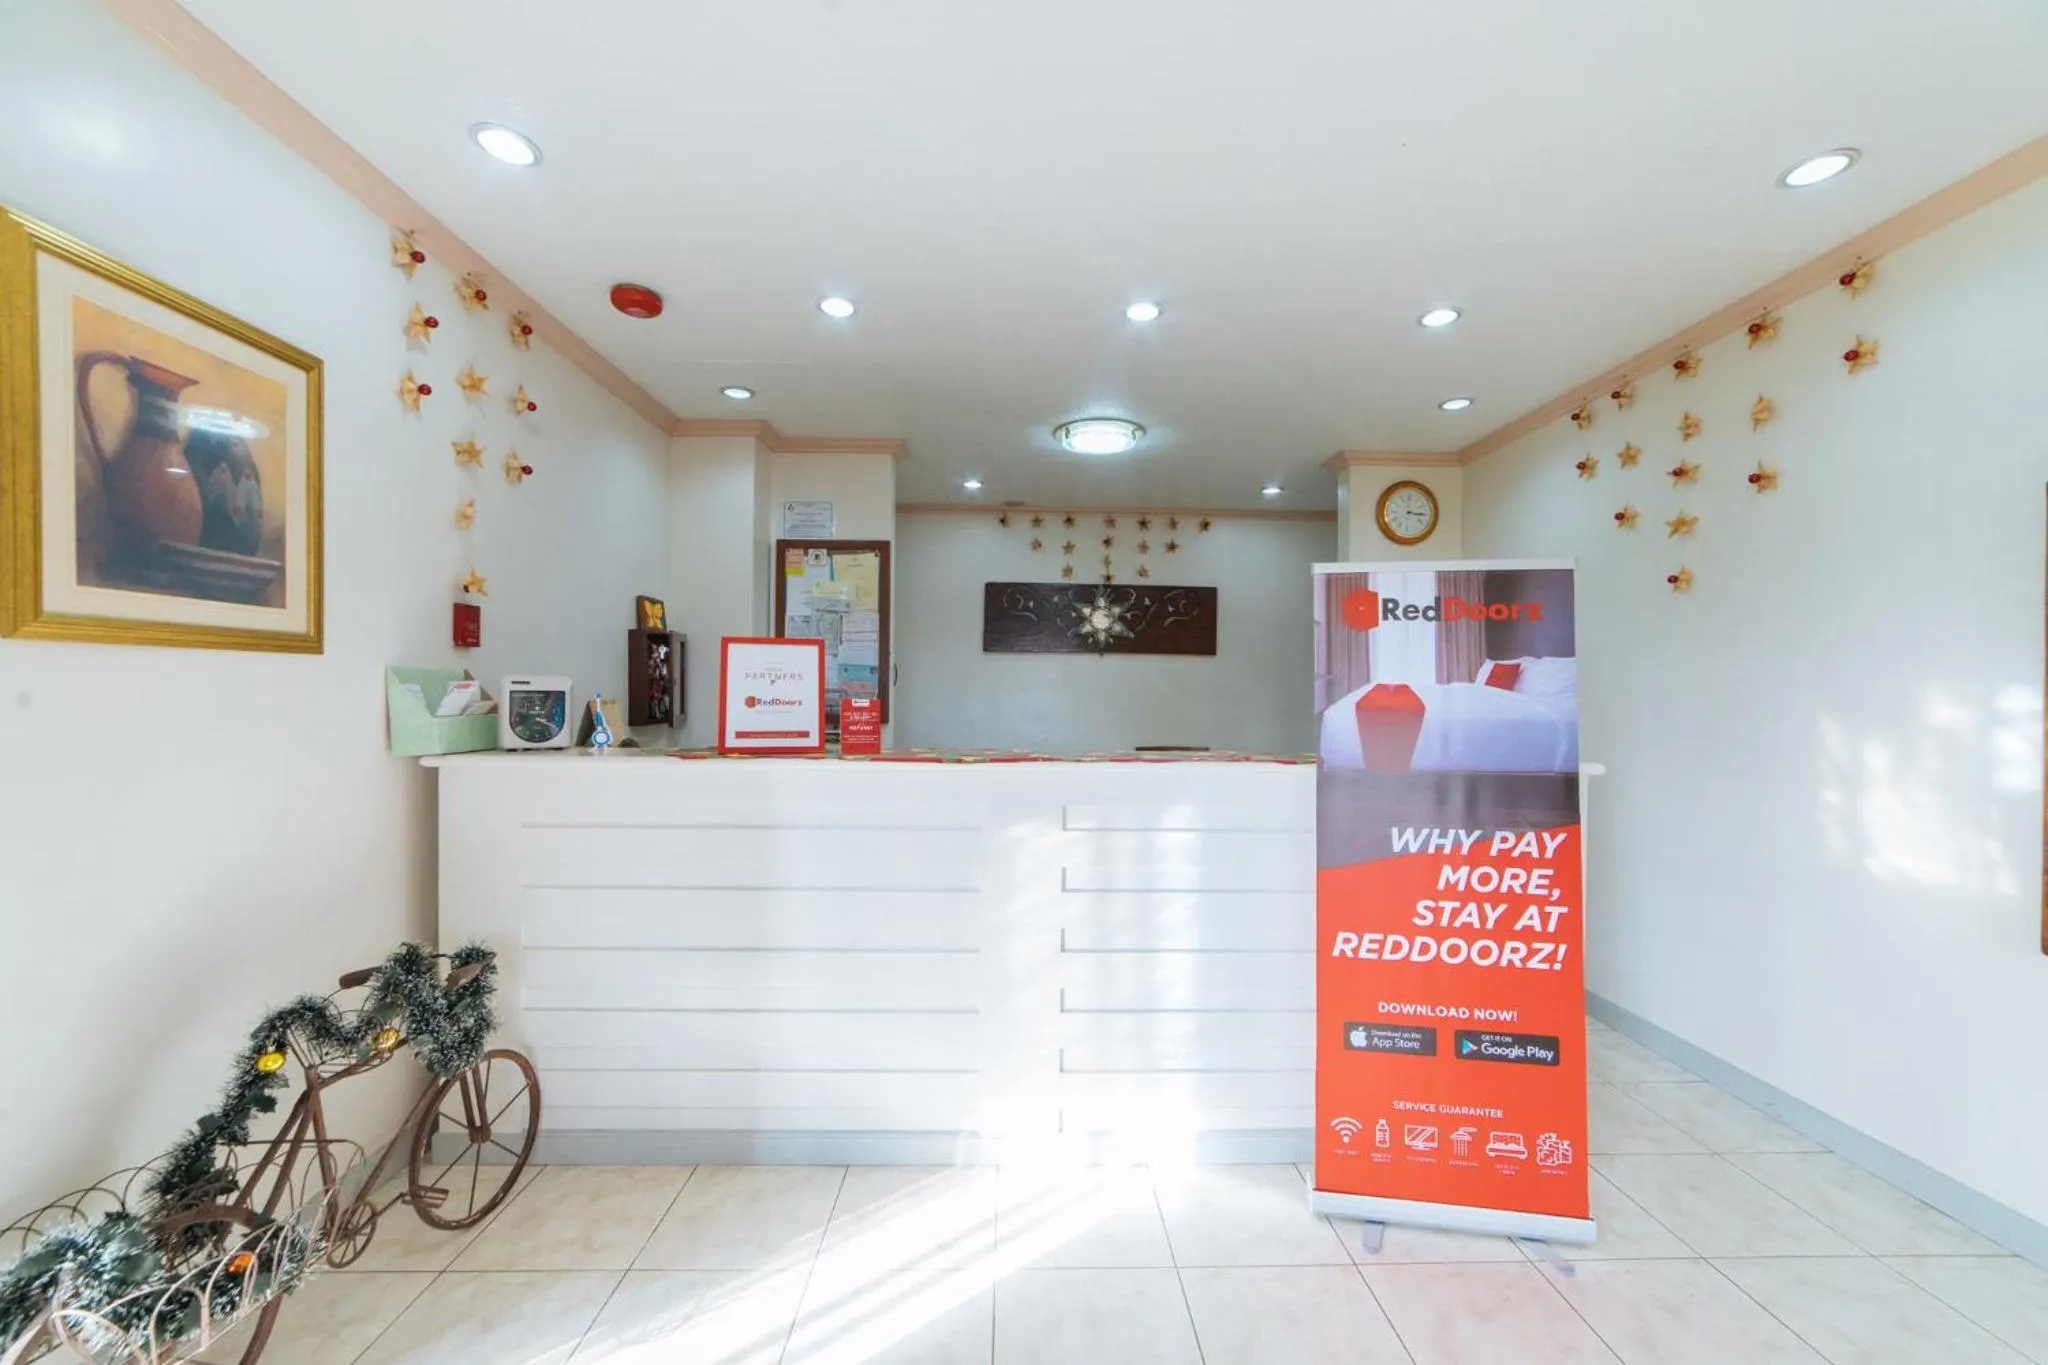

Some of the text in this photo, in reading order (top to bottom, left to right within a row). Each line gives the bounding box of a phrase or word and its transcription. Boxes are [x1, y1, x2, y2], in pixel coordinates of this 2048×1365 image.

[1381, 597, 1543, 622] RedDoorz
[1391, 827, 1567, 859] WHY PAY
[1437, 864, 1561, 901] MORE,
[1412, 899, 1569, 933] STAY AT
[1332, 931, 1568, 971] REDDOORZ!
[1378, 1001, 1518, 1023] DOWNLOAD NOW!
[1372, 1037, 1421, 1049] App Store
[1481, 1042, 1555, 1062] Google Play
[1392, 1100, 1505, 1119] SERVICE GUARANTEE
